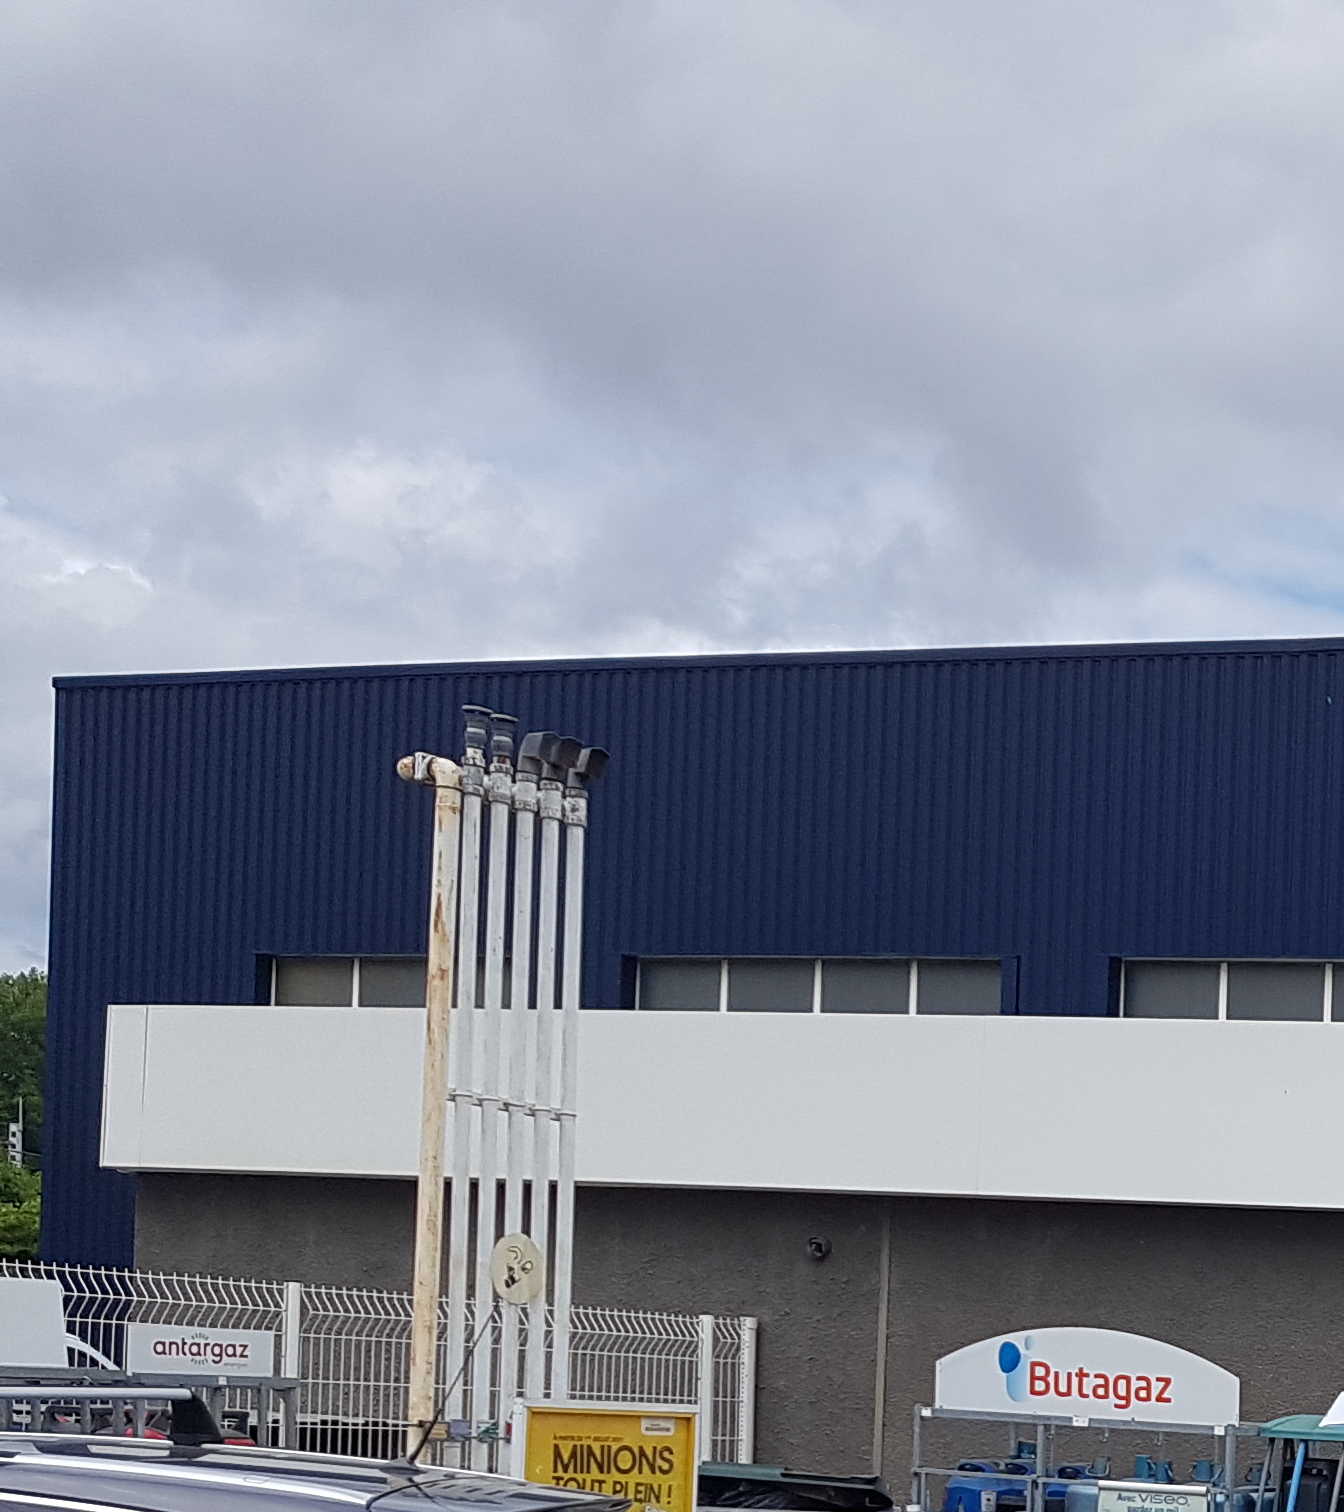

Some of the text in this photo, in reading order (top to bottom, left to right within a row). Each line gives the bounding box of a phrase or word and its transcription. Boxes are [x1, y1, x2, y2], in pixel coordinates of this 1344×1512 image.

[153, 1337, 249, 1365] antargaz
[1029, 1360, 1172, 1410] Butagaz
[552, 1443, 674, 1475] MINIONS
[667, 1484, 673, 1505] !
